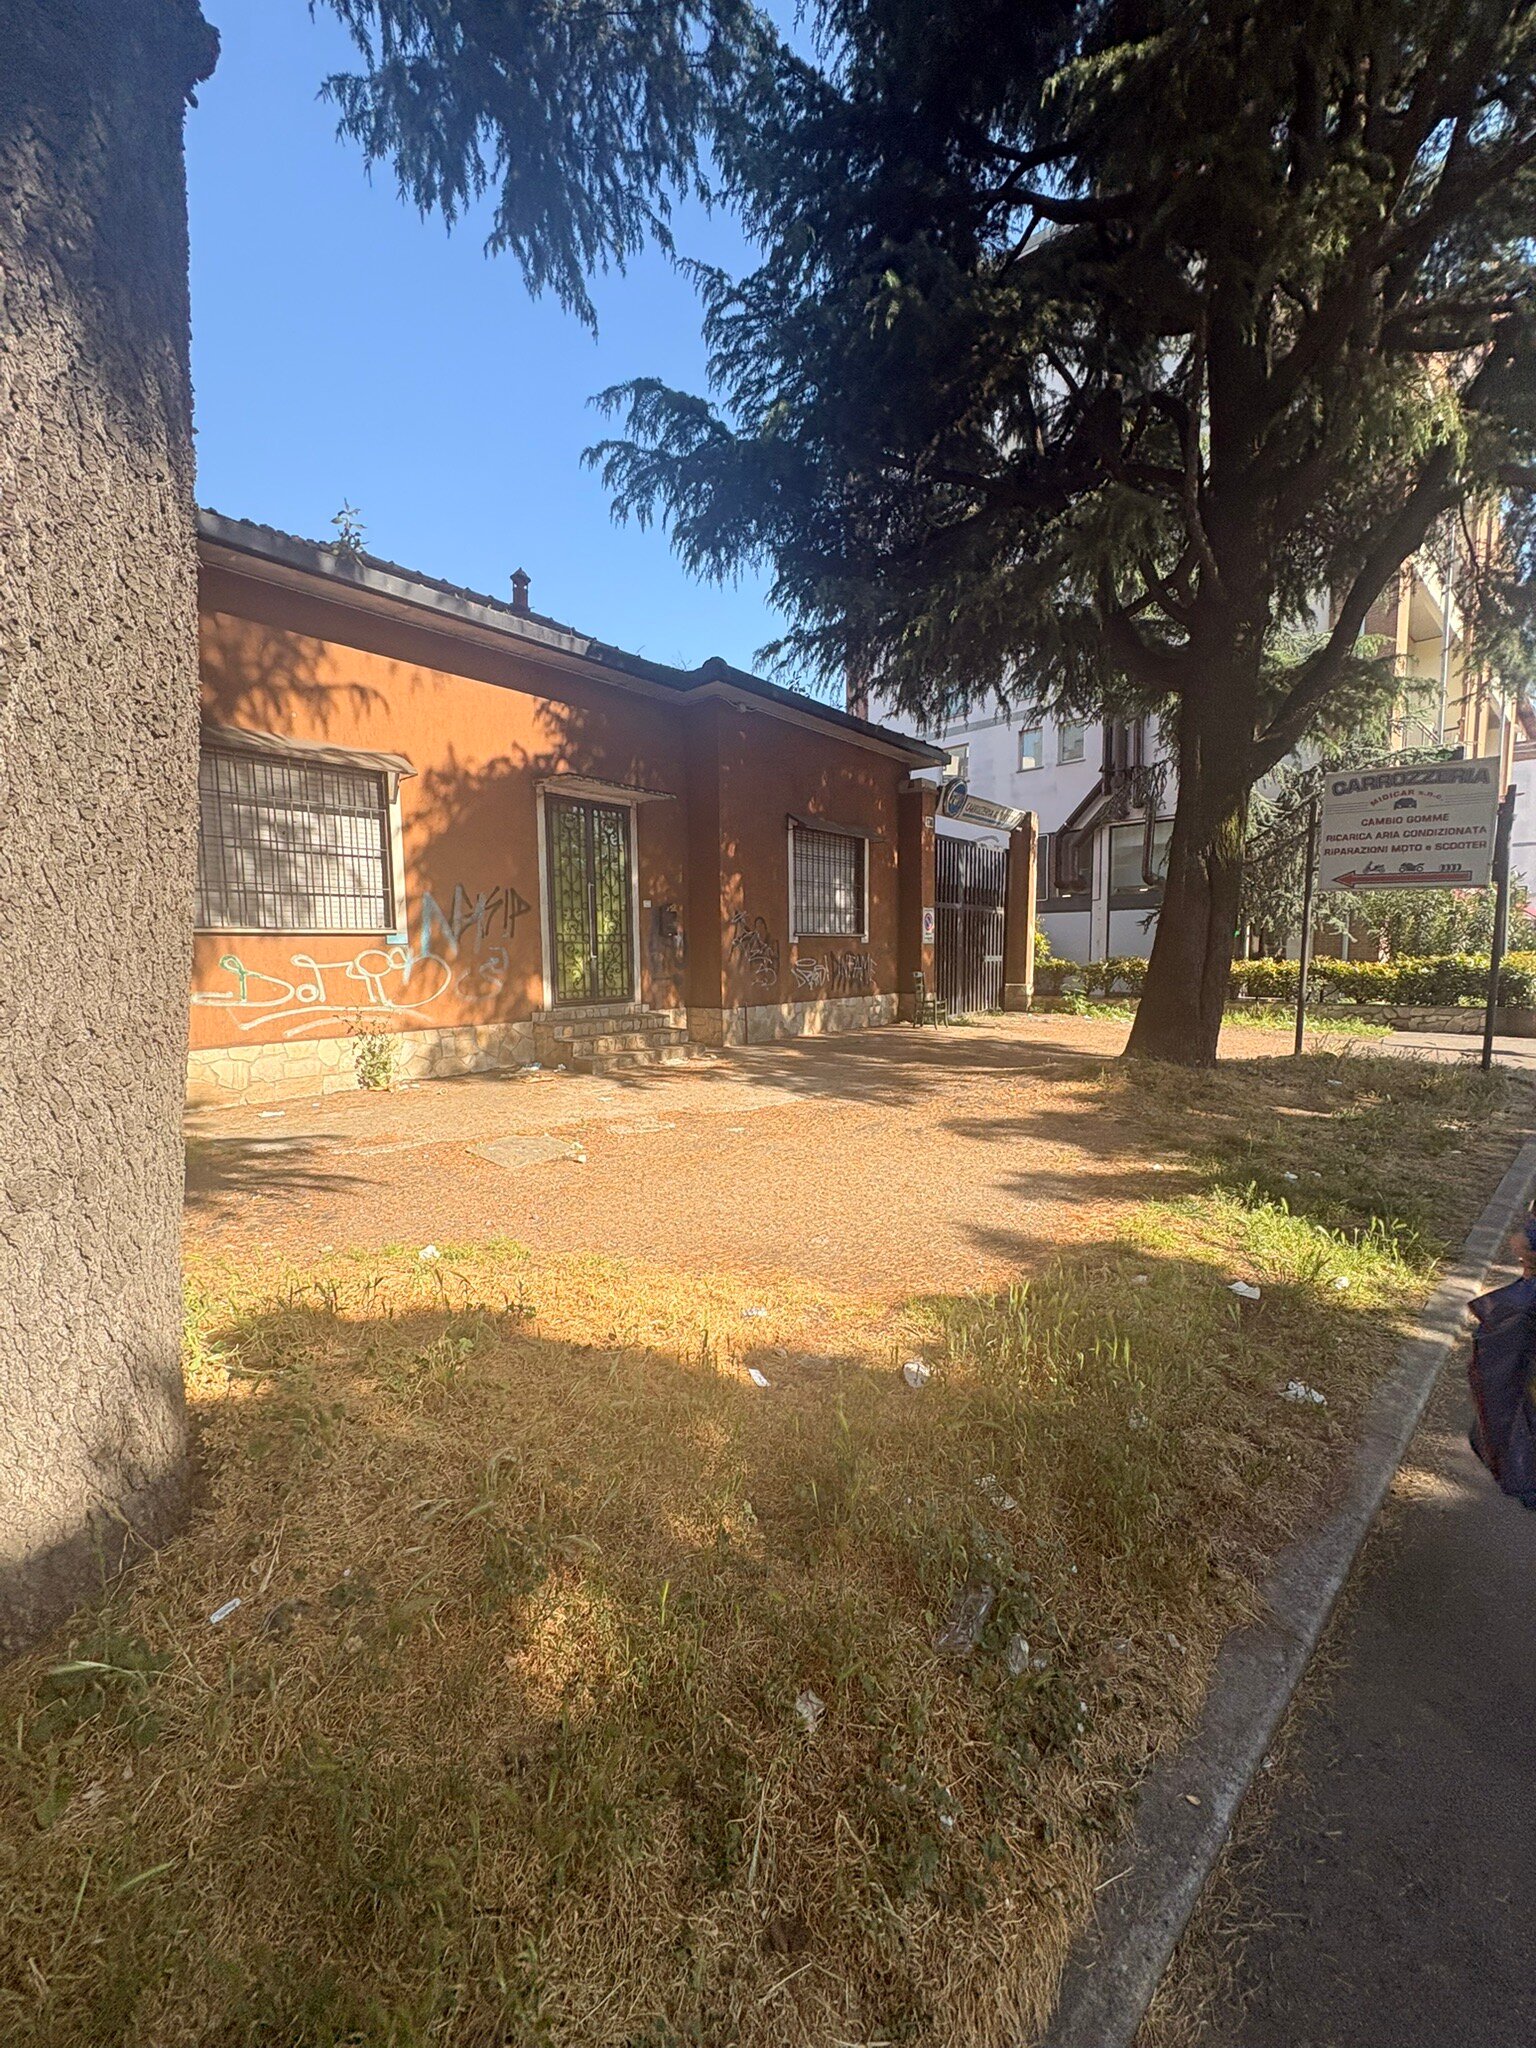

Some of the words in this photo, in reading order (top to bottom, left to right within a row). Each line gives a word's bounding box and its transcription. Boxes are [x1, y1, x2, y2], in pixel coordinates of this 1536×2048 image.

[1332, 767, 1490, 796] CARROZZERIA
[1370, 789, 1415, 807] MIDICAR
[1361, 816, 1403, 827] CAMBIO
[1406, 813, 1449, 824] GOMME
[1326, 833, 1373, 843] RICARICA
[1375, 831, 1400, 840] ARIA
[1402, 825, 1487, 838] CONDIZIONATA
[1323, 845, 1388, 857] RIPARAZIONI
[1391, 844, 1423, 853] MOTO
[1435, 841, 1487, 850] SCOOTER
